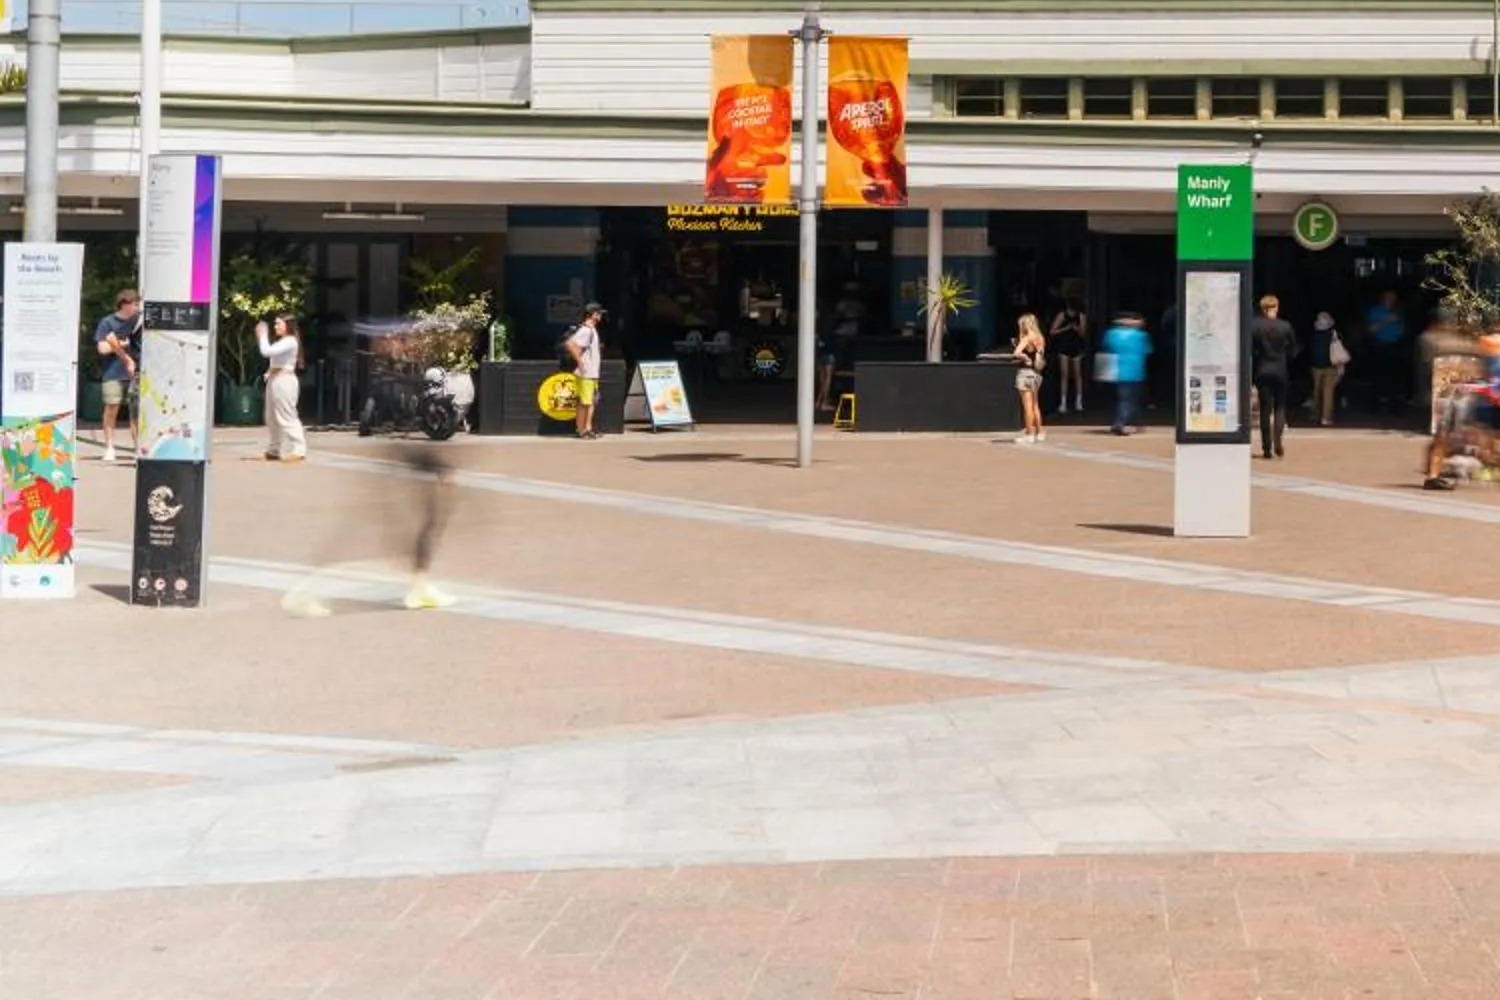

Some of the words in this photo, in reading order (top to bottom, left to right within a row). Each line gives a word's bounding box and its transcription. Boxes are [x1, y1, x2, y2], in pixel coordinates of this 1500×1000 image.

[839, 96, 891, 122] APEROL
[1187, 175, 1231, 192] Manly
[1187, 194, 1233, 208] Wharf
[667, 217, 718, 231] Mexican
[719, 217, 763, 231] Kitchen
[1310, 213, 1325, 237] F
